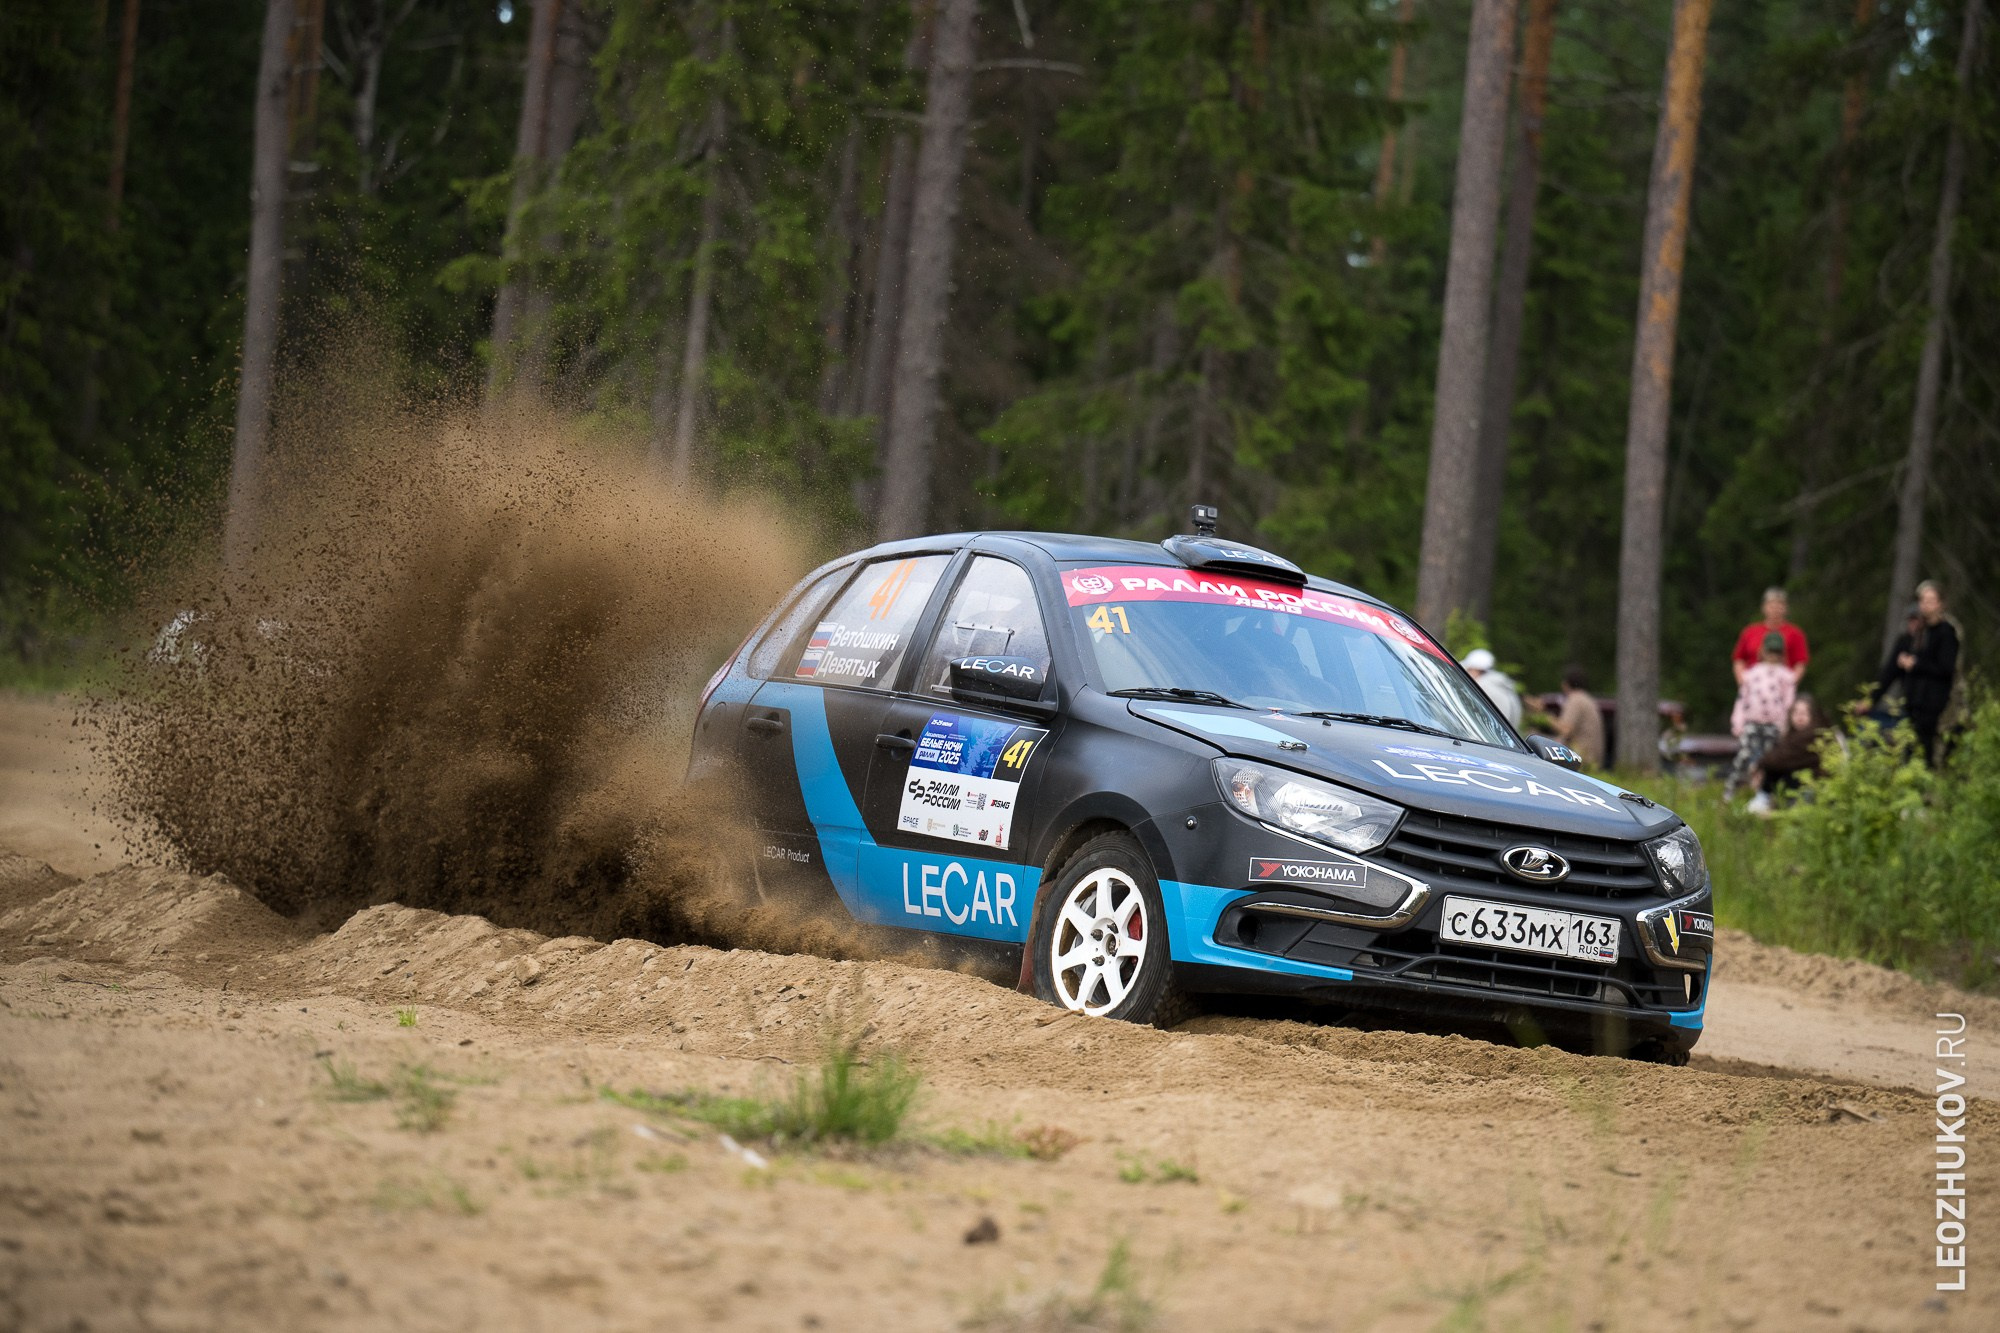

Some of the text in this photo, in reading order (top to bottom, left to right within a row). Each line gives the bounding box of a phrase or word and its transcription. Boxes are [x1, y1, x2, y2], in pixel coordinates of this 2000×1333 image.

[868, 559, 917, 621] 41
[1120, 577, 1390, 629] РАЛЛИ РОССИИ
[1087, 605, 1132, 634] 41
[816, 651, 881, 678] Девятых
[960, 658, 1035, 680] LECAR
[938, 750, 962, 765] 2025
[1002, 739, 1034, 769] 41
[927, 780, 960, 797] РАЛЛИ
[1371, 759, 1621, 813] LECAR
[922, 793, 962, 811] РОССИИ
[763, 845, 810, 863] LECAR Product
[1281, 864, 1357, 882] YOKOHAMA
[903, 862, 1018, 927] LECAR
[1451, 907, 1613, 950] С633МХ 163
[1578, 944, 1599, 957] RUS
